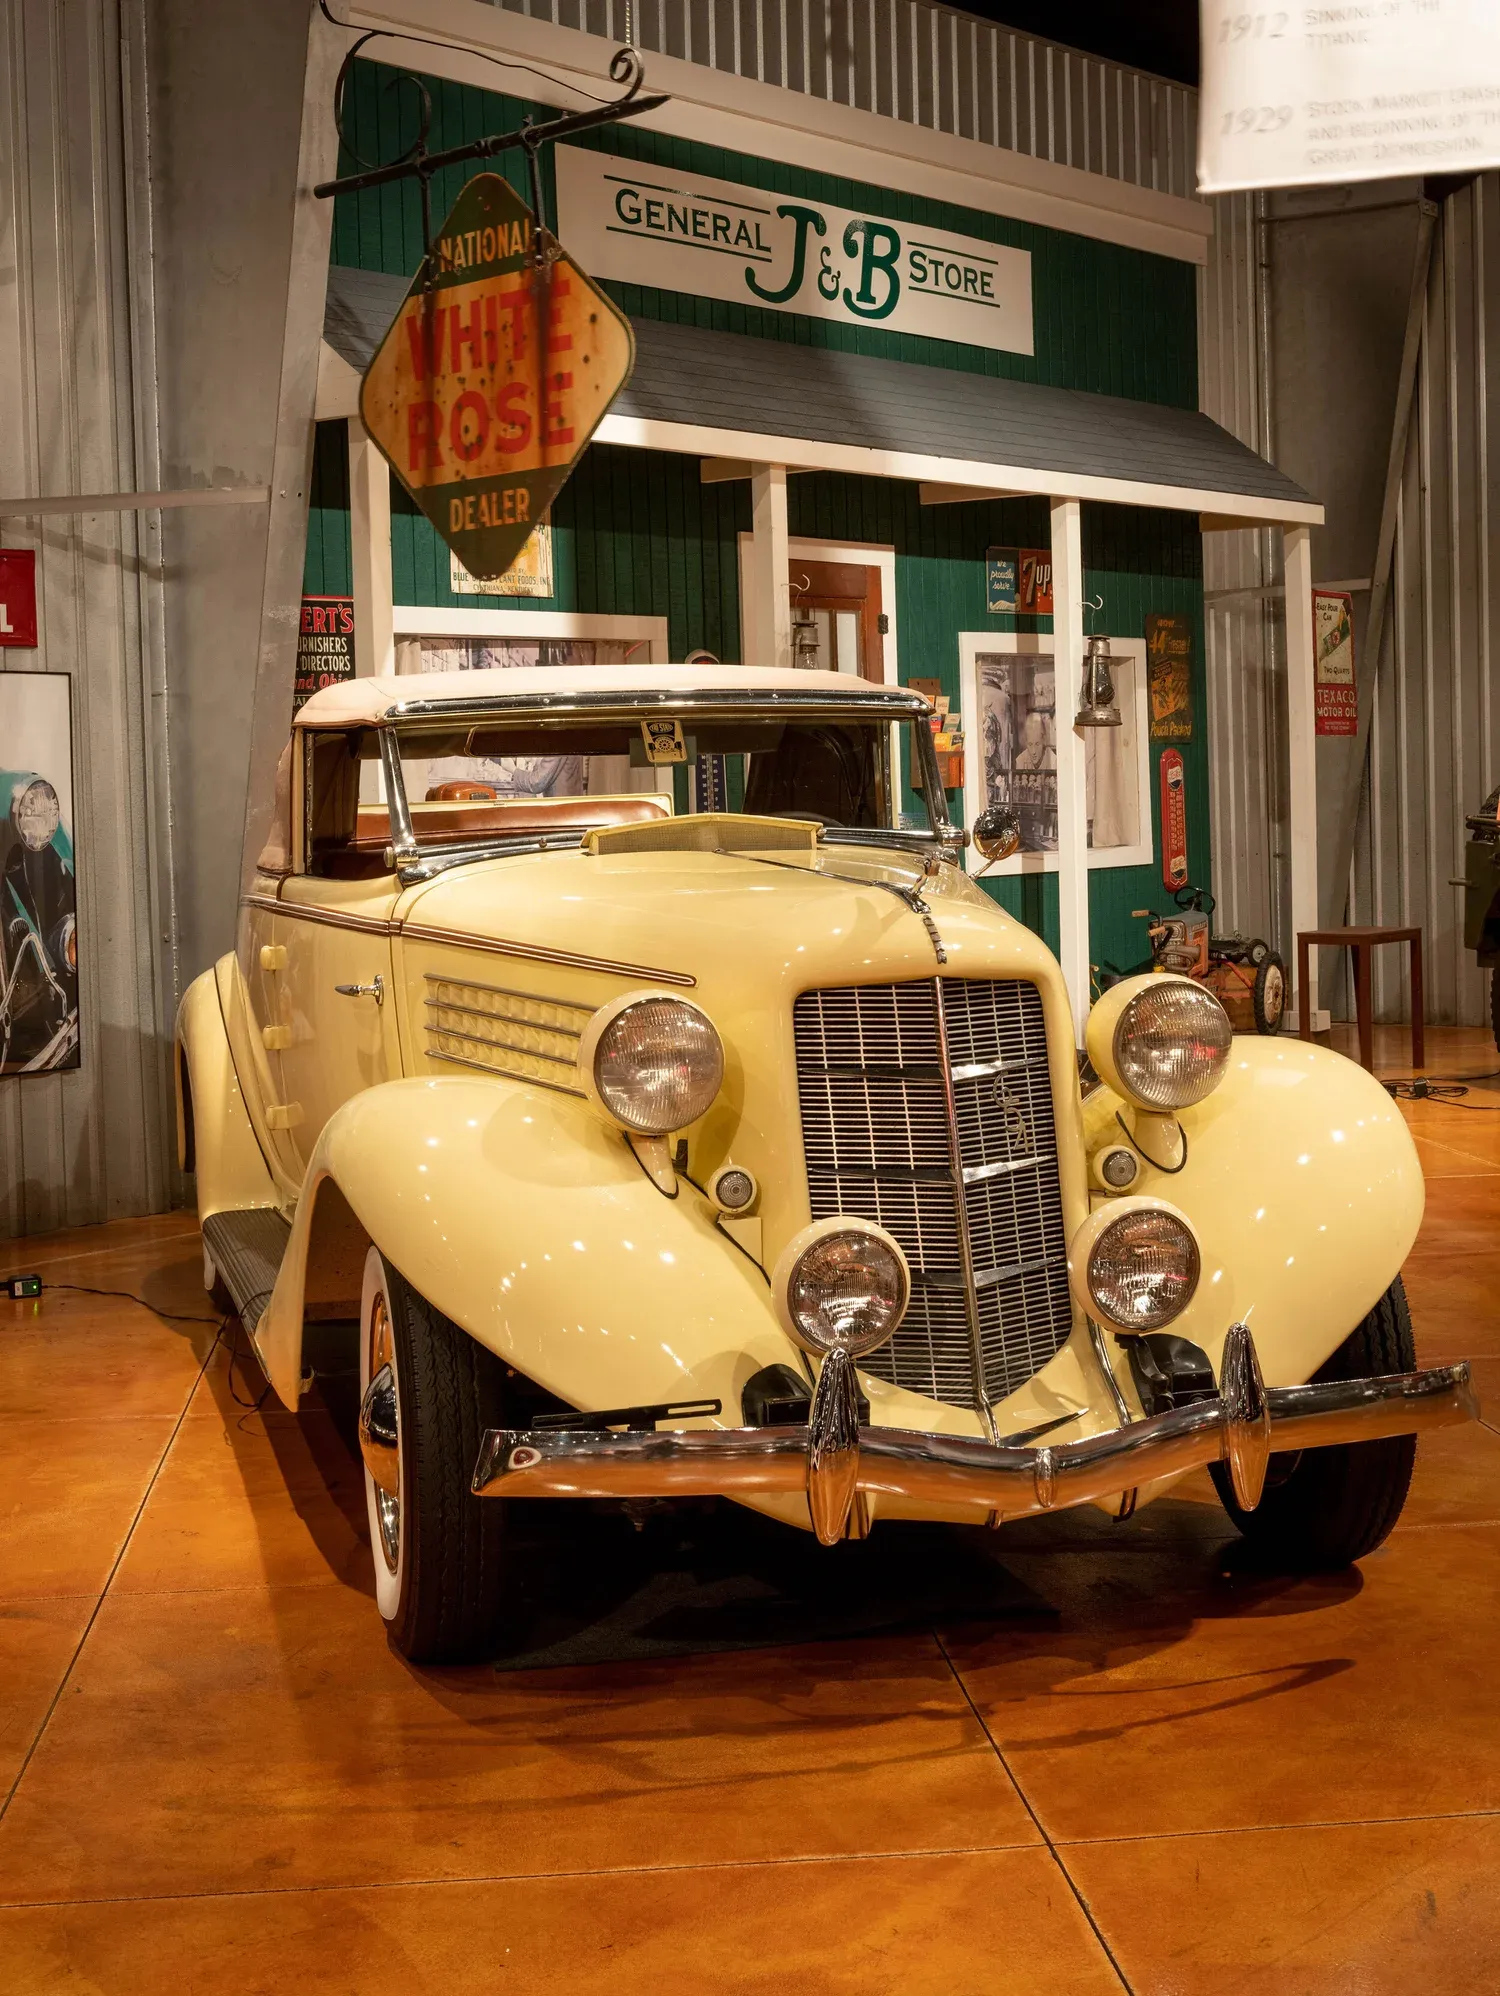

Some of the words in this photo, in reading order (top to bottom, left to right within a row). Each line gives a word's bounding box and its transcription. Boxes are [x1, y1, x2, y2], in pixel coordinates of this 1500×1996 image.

[1220, 12, 1289, 43] 1912
[1221, 105, 1294, 136] 1929
[614, 188, 772, 253] GENERAL
[908, 250, 996, 299] STORE
[406, 278, 574, 382] WHITE
[407, 371, 575, 472] ROSE
[450, 487, 530, 533] DEALER
[453, 572, 469, 582] BLUE
[496, 574, 515, 585] LANT
[301, 655, 351, 671] DIRECTORS
[319, 673, 349, 689] Ohi
[1318, 690, 1355, 703] TEXACO
[1317, 707, 1342, 717] MOTOR
[1345, 708, 1356, 717] OIL
